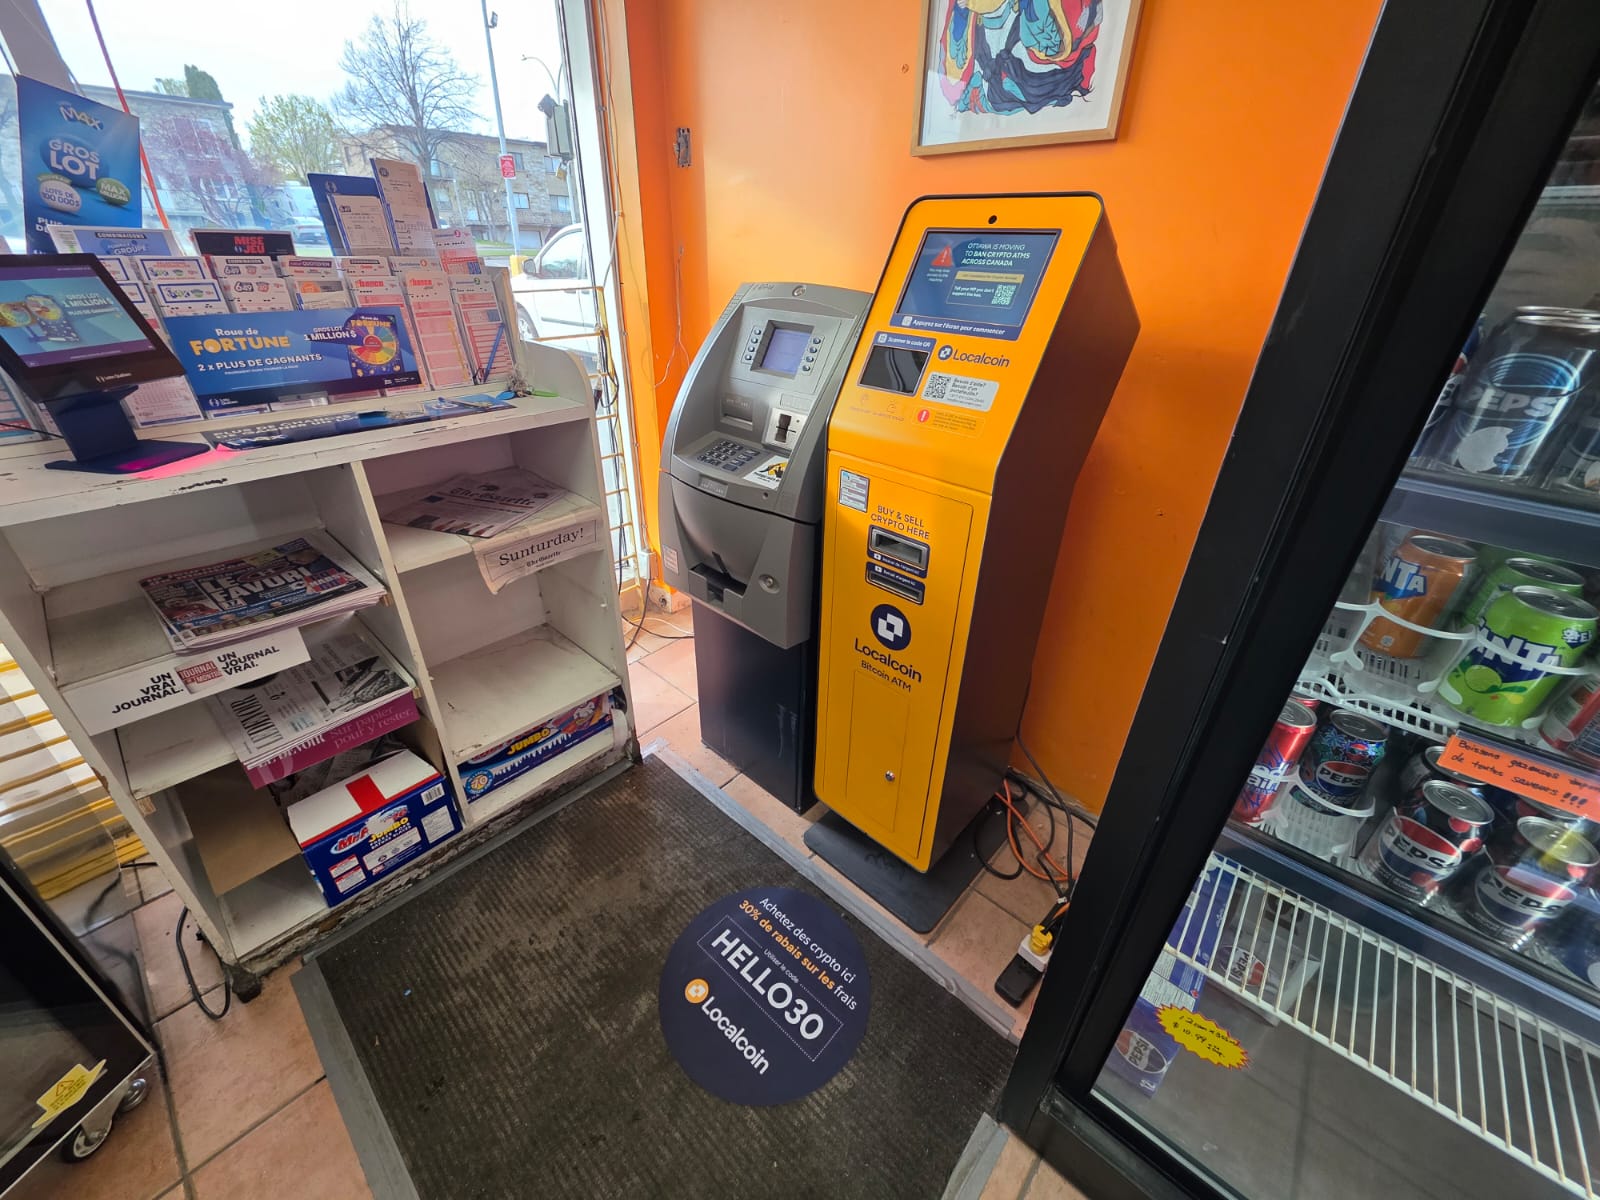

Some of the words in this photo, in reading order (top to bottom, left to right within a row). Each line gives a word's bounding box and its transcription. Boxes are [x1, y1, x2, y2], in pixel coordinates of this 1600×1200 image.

[48, 139, 100, 163] GROS
[50, 150, 100, 180] LOT
[234, 236, 264, 245] MISE
[243, 244, 266, 255] JEU
[998, 243, 1026, 251] MOVING
[960, 258, 986, 266] ACROSS
[986, 259, 1013, 267] CANADA
[986, 251, 1012, 259] CRYPTO
[215, 328, 243, 337] Roue
[245, 328, 259, 336] de
[303, 333, 311, 341] 1
[310, 331, 350, 341] MILLION
[350, 330, 357, 339] $
[912, 319, 934, 328] Appuyez
[972, 326, 1006, 335] commencer
[189, 335, 291, 356] FORTUNE
[197, 363, 206, 372] 2
[216, 359, 246, 370] PLUS
[248, 359, 264, 367] DE
[265, 353, 323, 366] GAGNANTS
[953, 349, 1010, 368] Localcoin
[870, 513, 905, 531] CRYPTO
[906, 526, 930, 540] HERE
[877, 504, 895, 517] BUY
[896, 511, 902, 520] &
[904, 514, 925, 528] SELL
[498, 527, 585, 567] Sunturday!
[201, 577, 234, 594] LE
[217, 651, 237, 663] UN
[222, 645, 280, 670] JOURNAL
[223, 661, 259, 676] VRAI.
[854, 637, 923, 683] Localcoin
[150, 671, 172, 685] UN
[180, 662, 218, 679] JOURNAL
[861, 660, 890, 682] Bitcoin
[890, 676, 912, 693] ATM
[139, 679, 177, 696] VRAI
[111, 687, 184, 715] JOURNAL.
[330, 724, 352, 739] Sur
[355, 706, 394, 733] papier
[334, 731, 364, 749] pour
[508, 728, 550, 755] JUMBO
[1451, 752, 1465, 764] de
[1471, 760, 1504, 777] toutes
[1511, 776, 1559, 796] saveurs
[368, 817, 409, 843] JUMBO
[759, 897, 796, 931] Achetez
[792, 928, 812, 946] des
[809, 942, 842, 973] crypto
[840, 967, 857, 984] ici
[738, 899, 763, 921] 30%
[759, 918, 773, 933] de
[771, 930, 803, 960] rabais
[800, 957, 820, 975] sur
[817, 970, 836, 991] les
[832, 985, 858, 1011] frais
[763, 948, 782, 967] Utiliser
[784, 969, 800, 984] code
[711, 928, 824, 1041] HELLO30
[701, 996, 770, 1075] Localcoin
[1128, 1038, 1150, 1066] PEPSI
